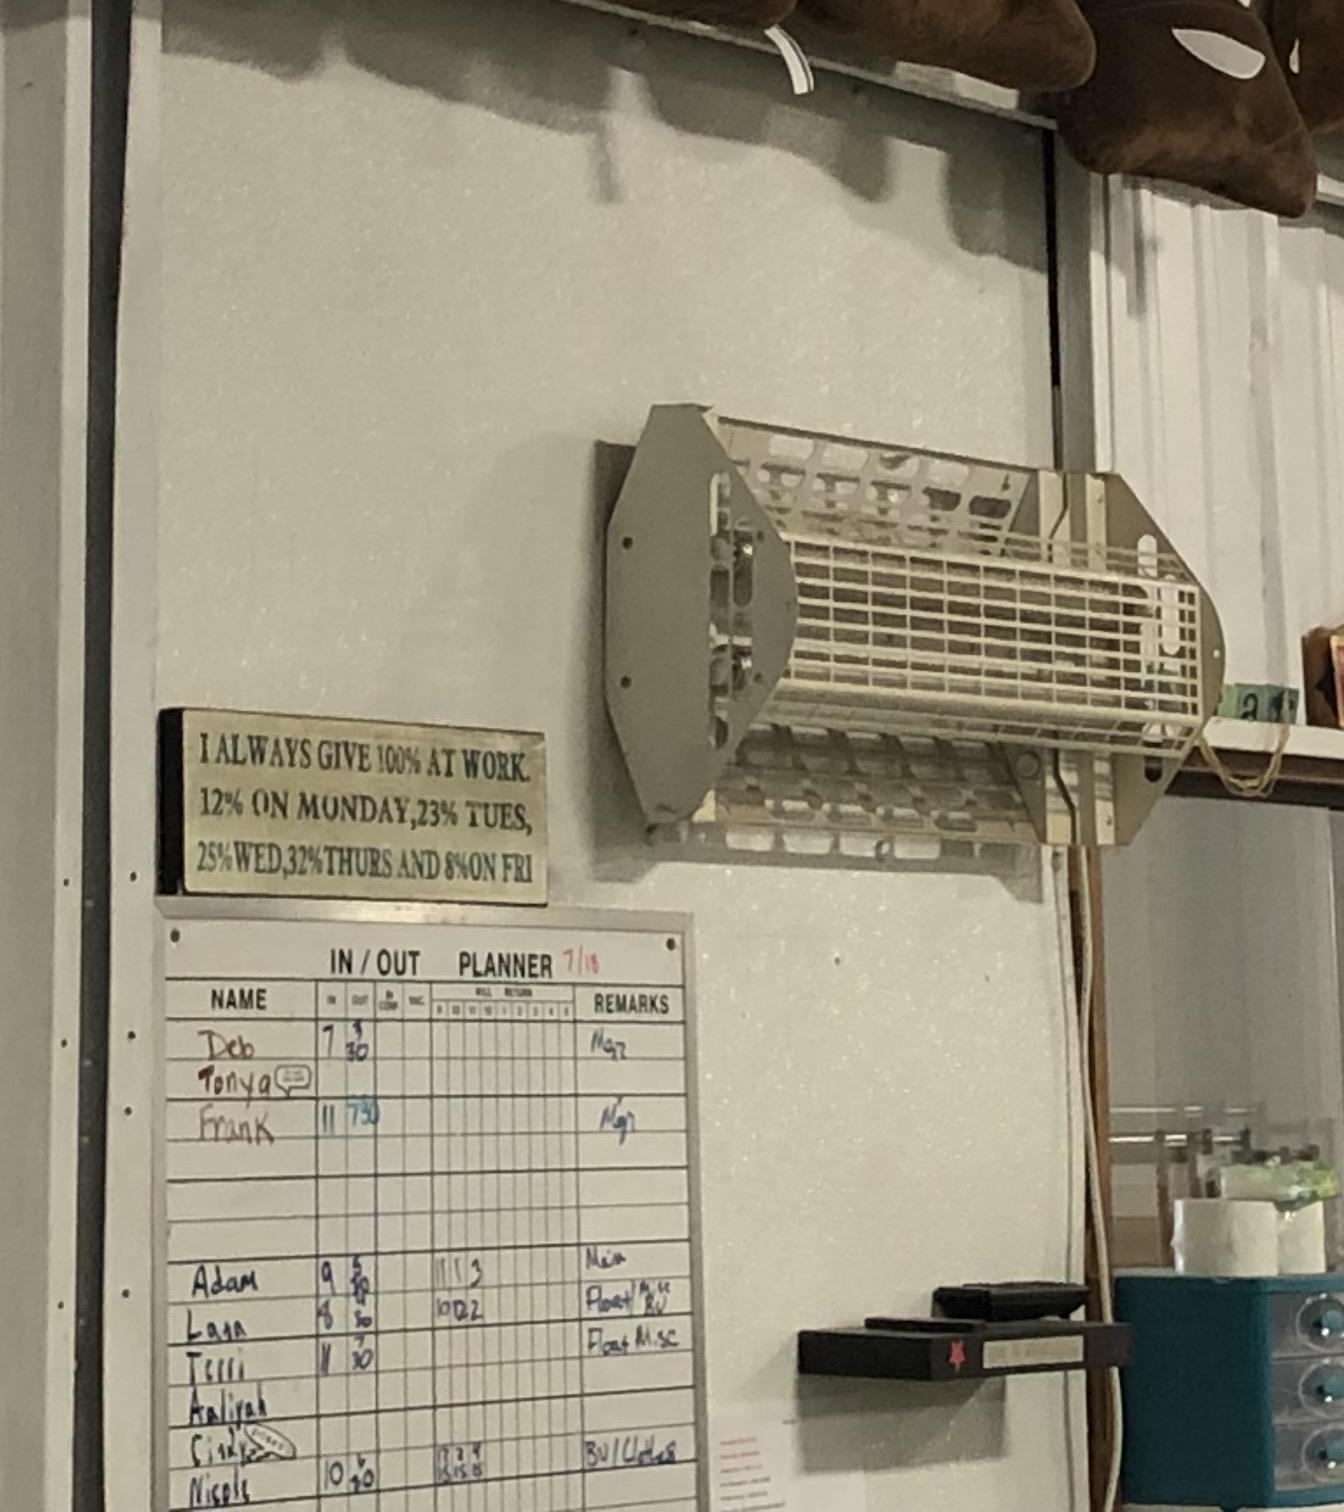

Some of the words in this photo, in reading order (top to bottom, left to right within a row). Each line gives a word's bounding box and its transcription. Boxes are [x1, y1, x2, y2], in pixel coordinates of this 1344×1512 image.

[200, 732, 209, 764] I
[215, 733, 312, 769] ALWAYS
[317, 739, 372, 773] GIVE
[377, 743, 421, 775] 100%
[427, 747, 456, 777] AT
[462, 748, 531, 783] WORK.
[200, 787, 244, 817] 12%
[251, 788, 289, 820] ON
[397, 848, 441, 880] AND
[501, 852, 533, 884] FRI
[330, 947, 353, 975] IN
[376, 948, 421, 976] OUT
[459, 950, 553, 979] PLANNER
[211, 988, 267, 1010] NAME
[594, 992, 670, 1015] REMARKS
[197, 1028, 255, 1061] Deb
[198, 1064, 271, 1109] Tonya
[199, 1101, 275, 1147] Frank
[191, 1263, 259, 1299] Adam
